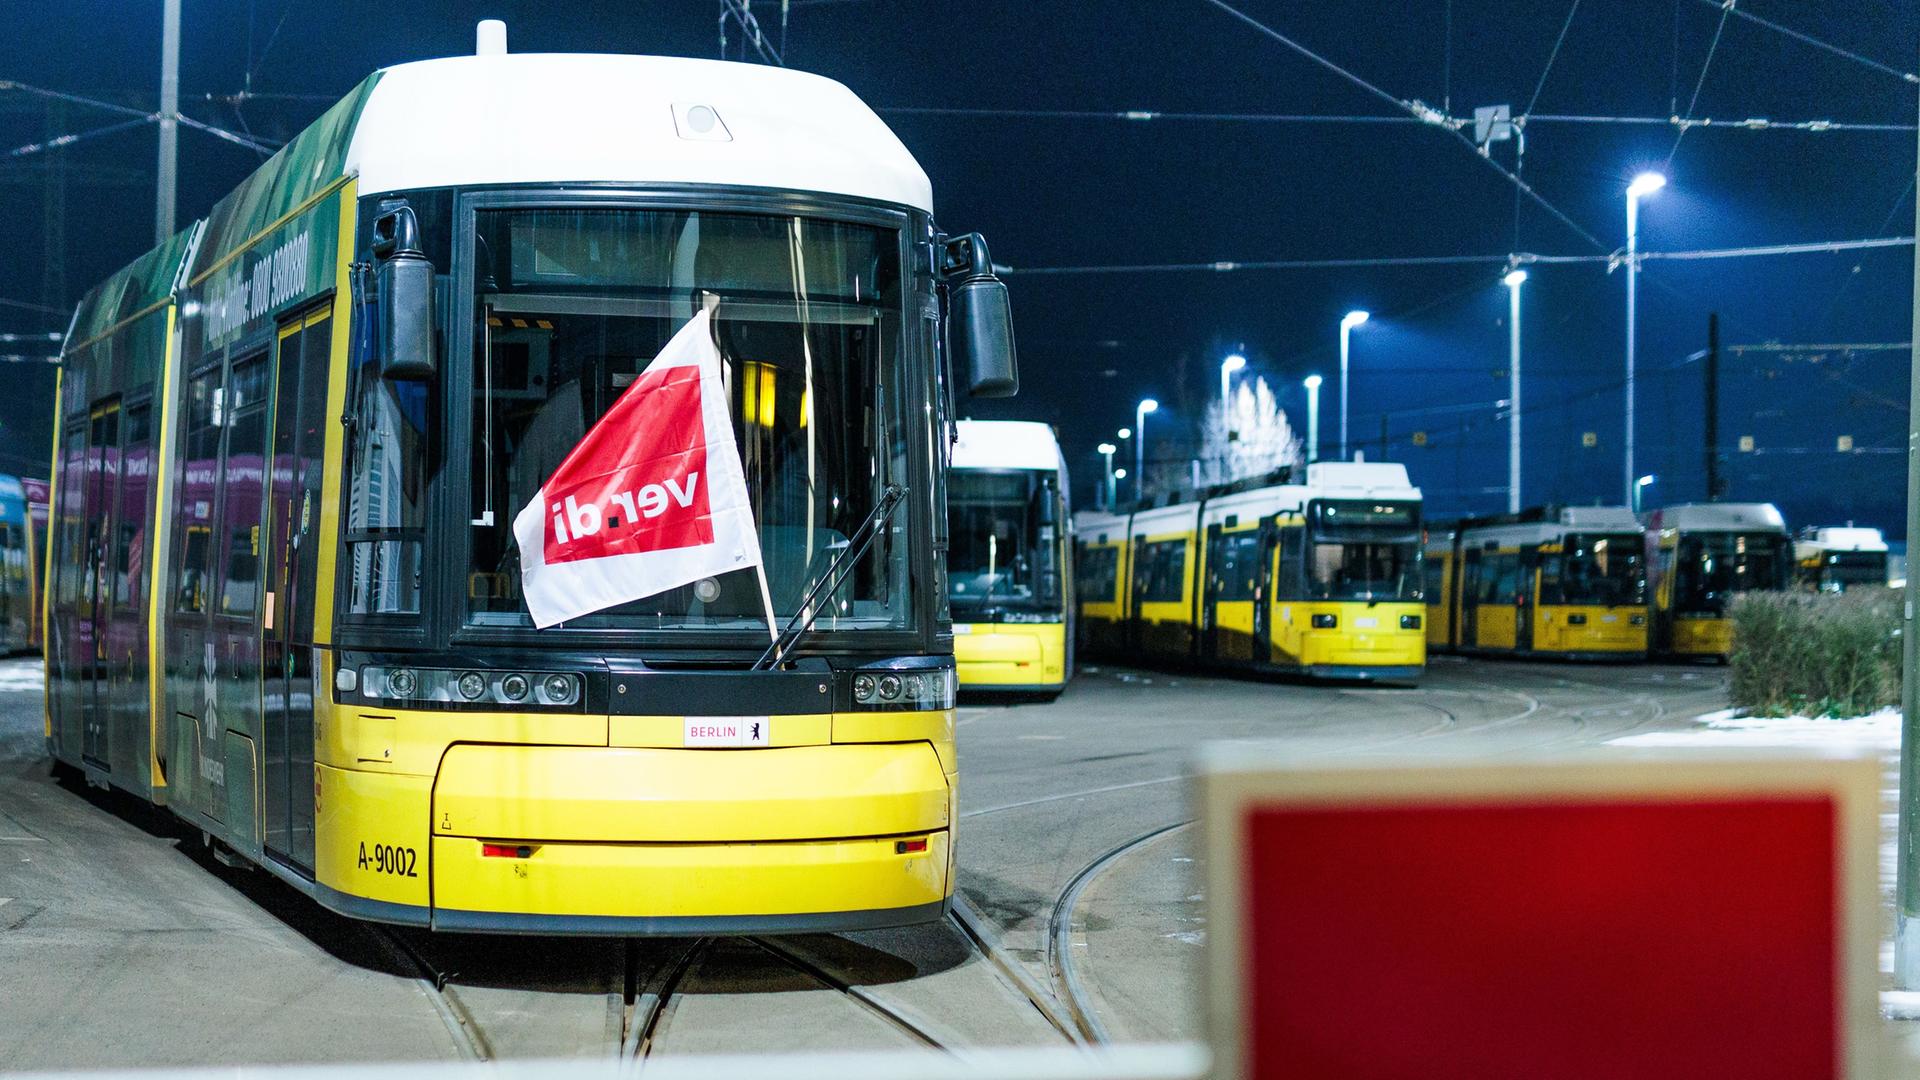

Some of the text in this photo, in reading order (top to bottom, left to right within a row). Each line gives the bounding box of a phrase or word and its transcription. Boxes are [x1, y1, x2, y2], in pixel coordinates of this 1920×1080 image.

[251, 254, 272, 320] 0800
[690, 726, 737, 738] BERLIN
[358, 841, 418, 878] A-9002
